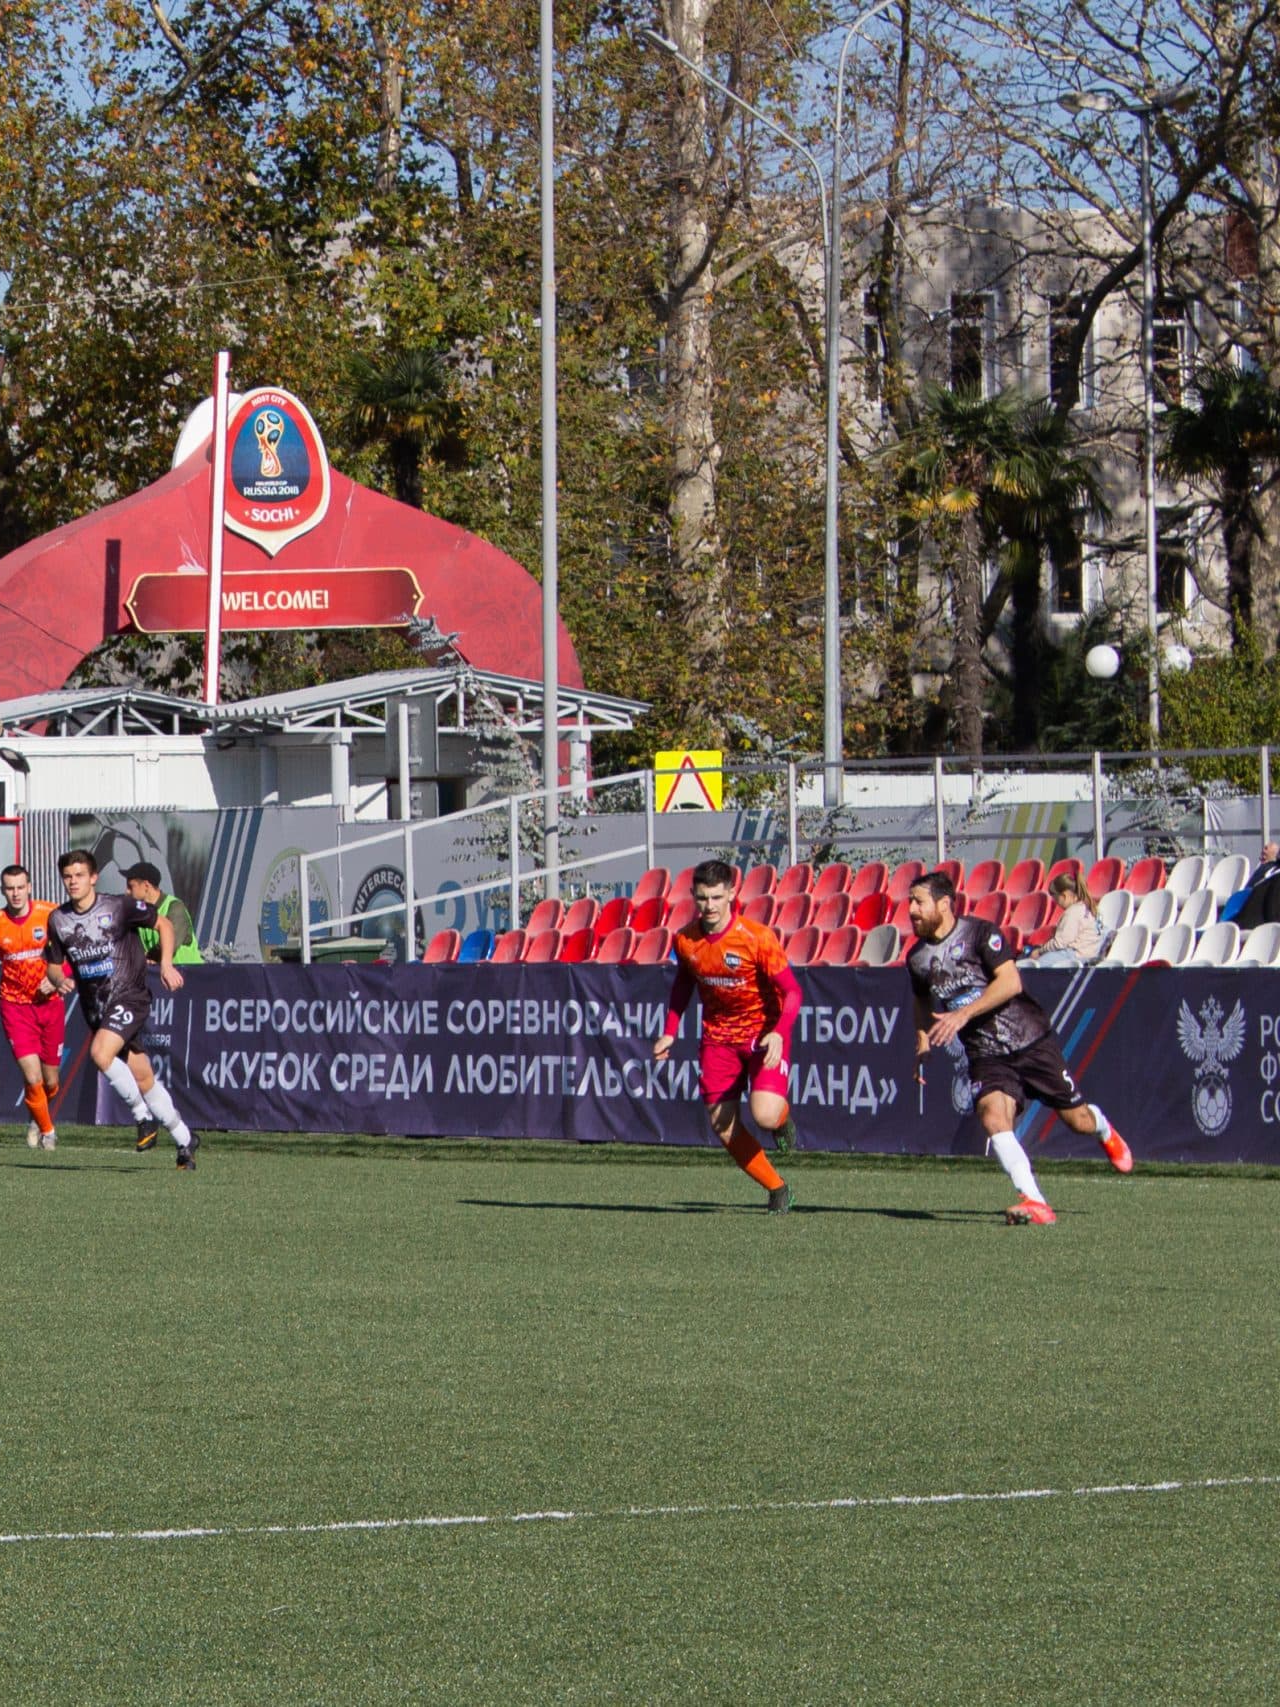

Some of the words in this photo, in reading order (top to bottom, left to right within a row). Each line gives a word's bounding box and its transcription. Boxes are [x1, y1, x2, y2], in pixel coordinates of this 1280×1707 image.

[243, 486, 277, 496] RUSSIA
[278, 485, 299, 496] 2018
[251, 507, 294, 523] SOCHI
[222, 589, 329, 611] WELCOME!
[110, 1004, 134, 1025] 29
[205, 991, 439, 1035] ВСЕРОССИЙСКИЕ
[798, 1006, 900, 1044] ТБОЛУ
[202, 1051, 321, 1091] «КУБОК
[330, 1053, 434, 1100] СРЕДИ
